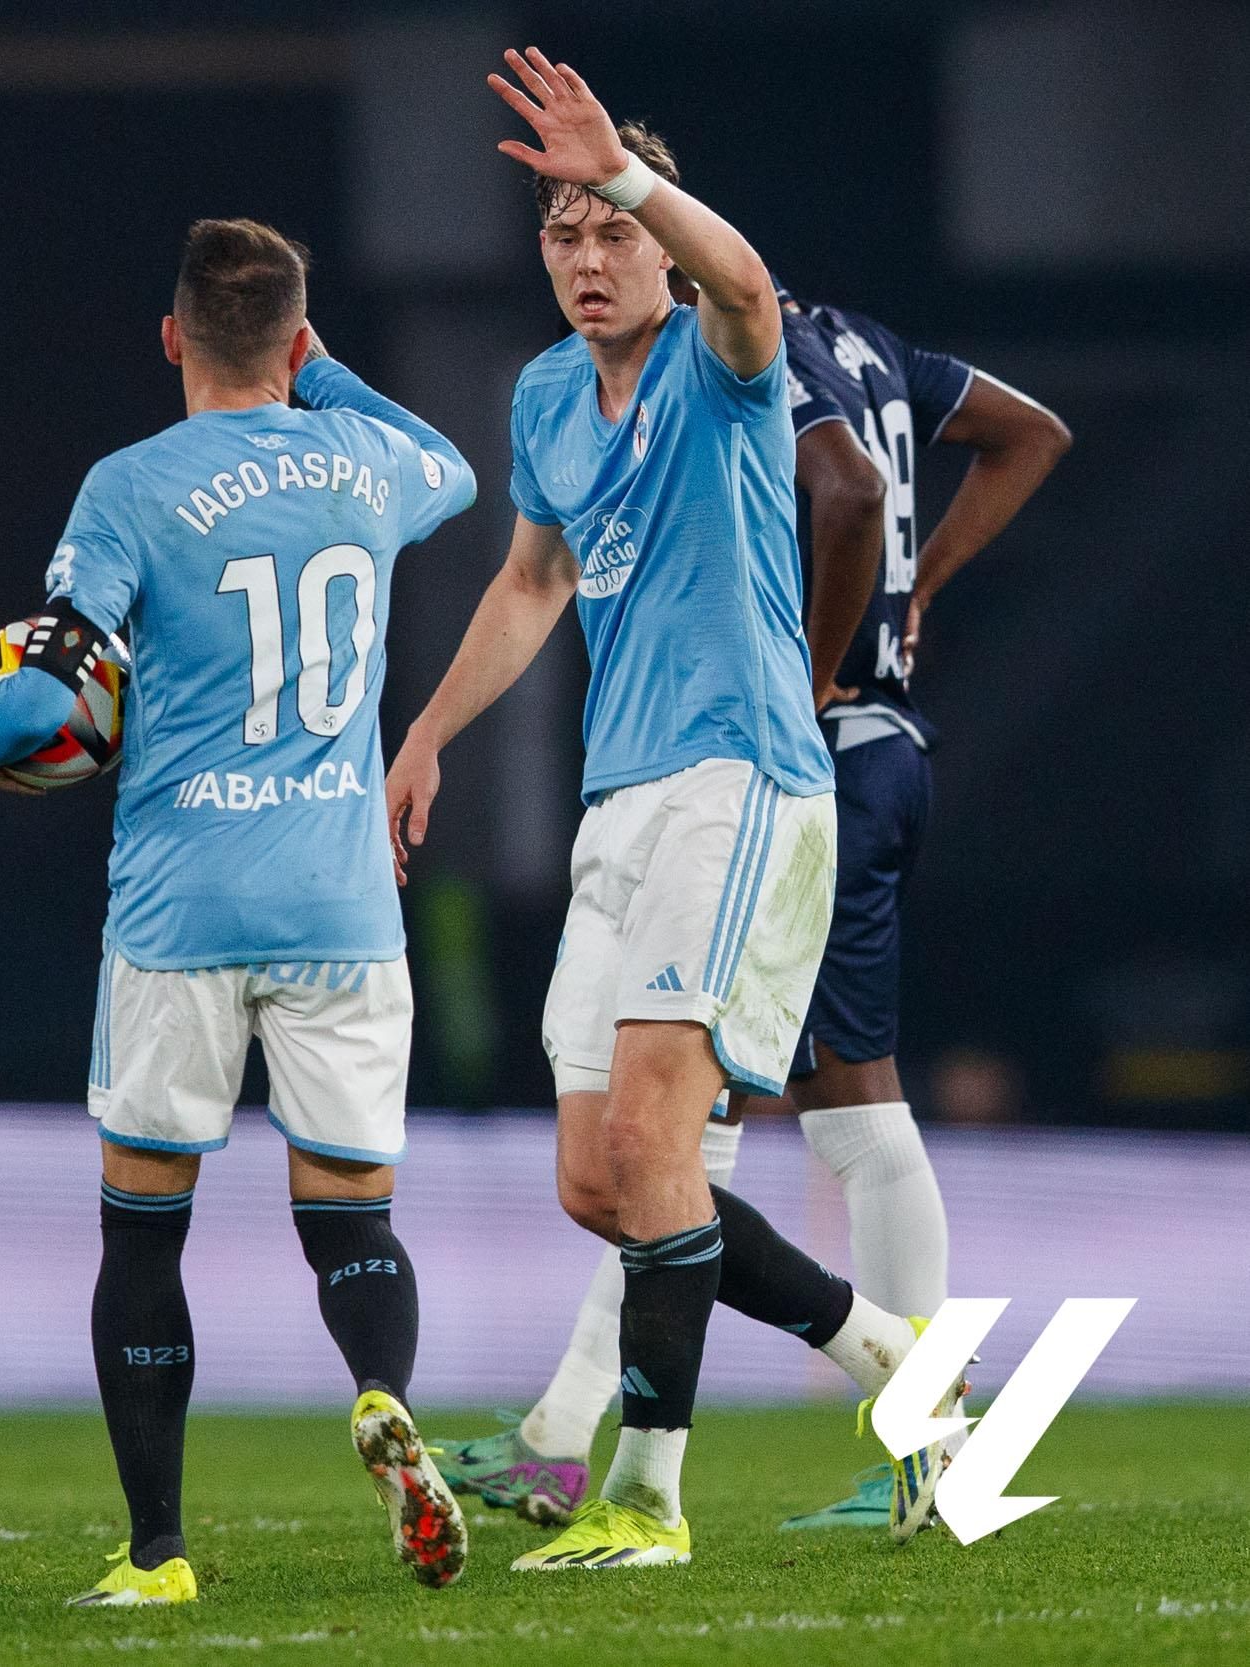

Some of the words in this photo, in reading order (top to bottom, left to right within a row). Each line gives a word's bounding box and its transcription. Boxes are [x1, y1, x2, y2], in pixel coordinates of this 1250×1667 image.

[176, 460, 269, 536] IAGO
[277, 452, 390, 517] ASPAS
[863, 399, 916, 594] 19
[215, 543, 376, 745] 10
[329, 1259, 398, 1286] 2023
[123, 1345, 189, 1366] 1923
